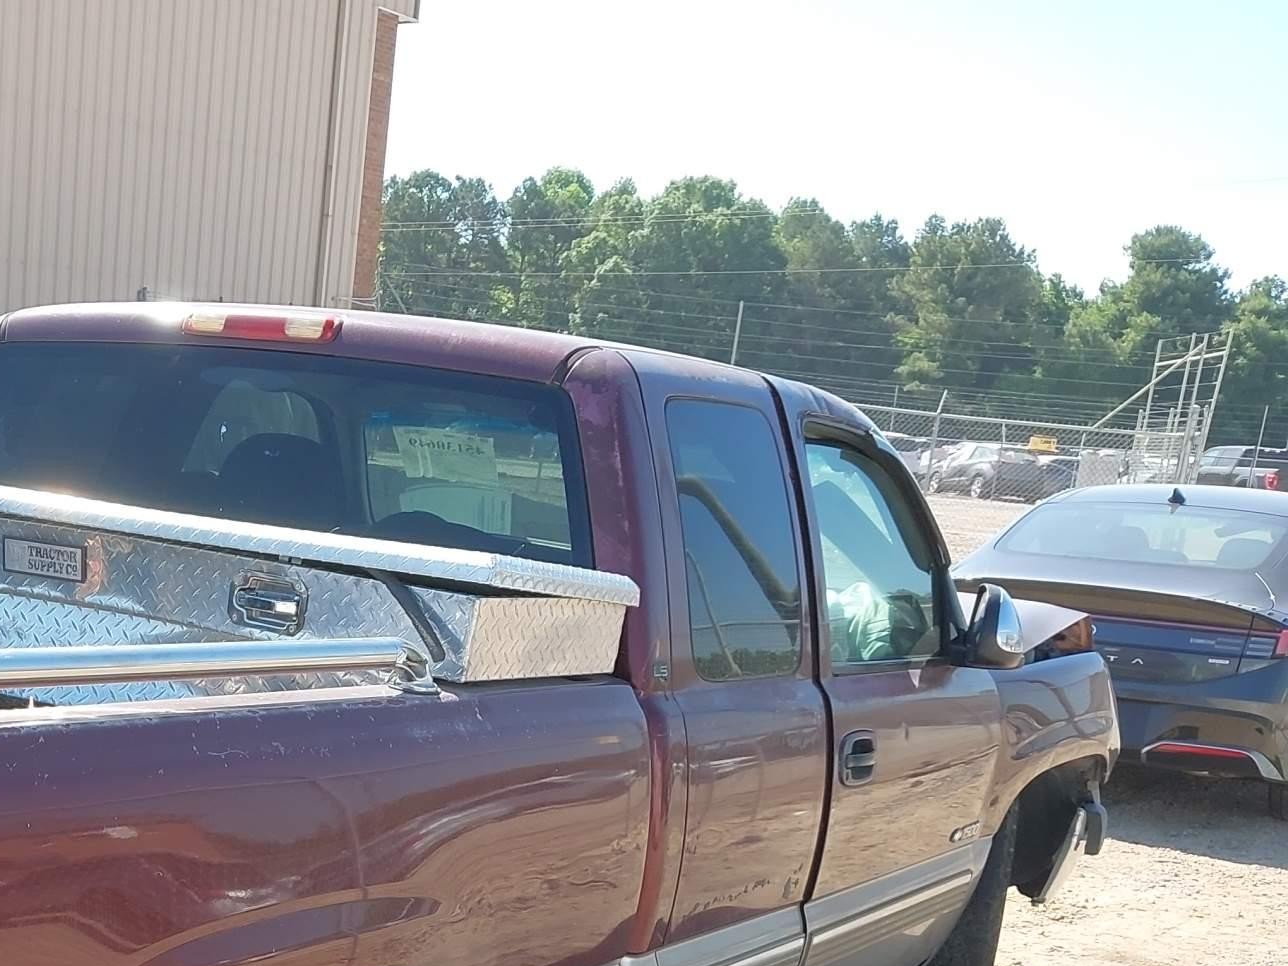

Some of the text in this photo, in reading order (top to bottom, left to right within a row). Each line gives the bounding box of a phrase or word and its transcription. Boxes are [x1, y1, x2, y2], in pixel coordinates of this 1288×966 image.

[27, 545, 78, 564] TRACTOR
[27, 558, 65, 575] SUPPLY
[654, 665, 669, 677] LS
